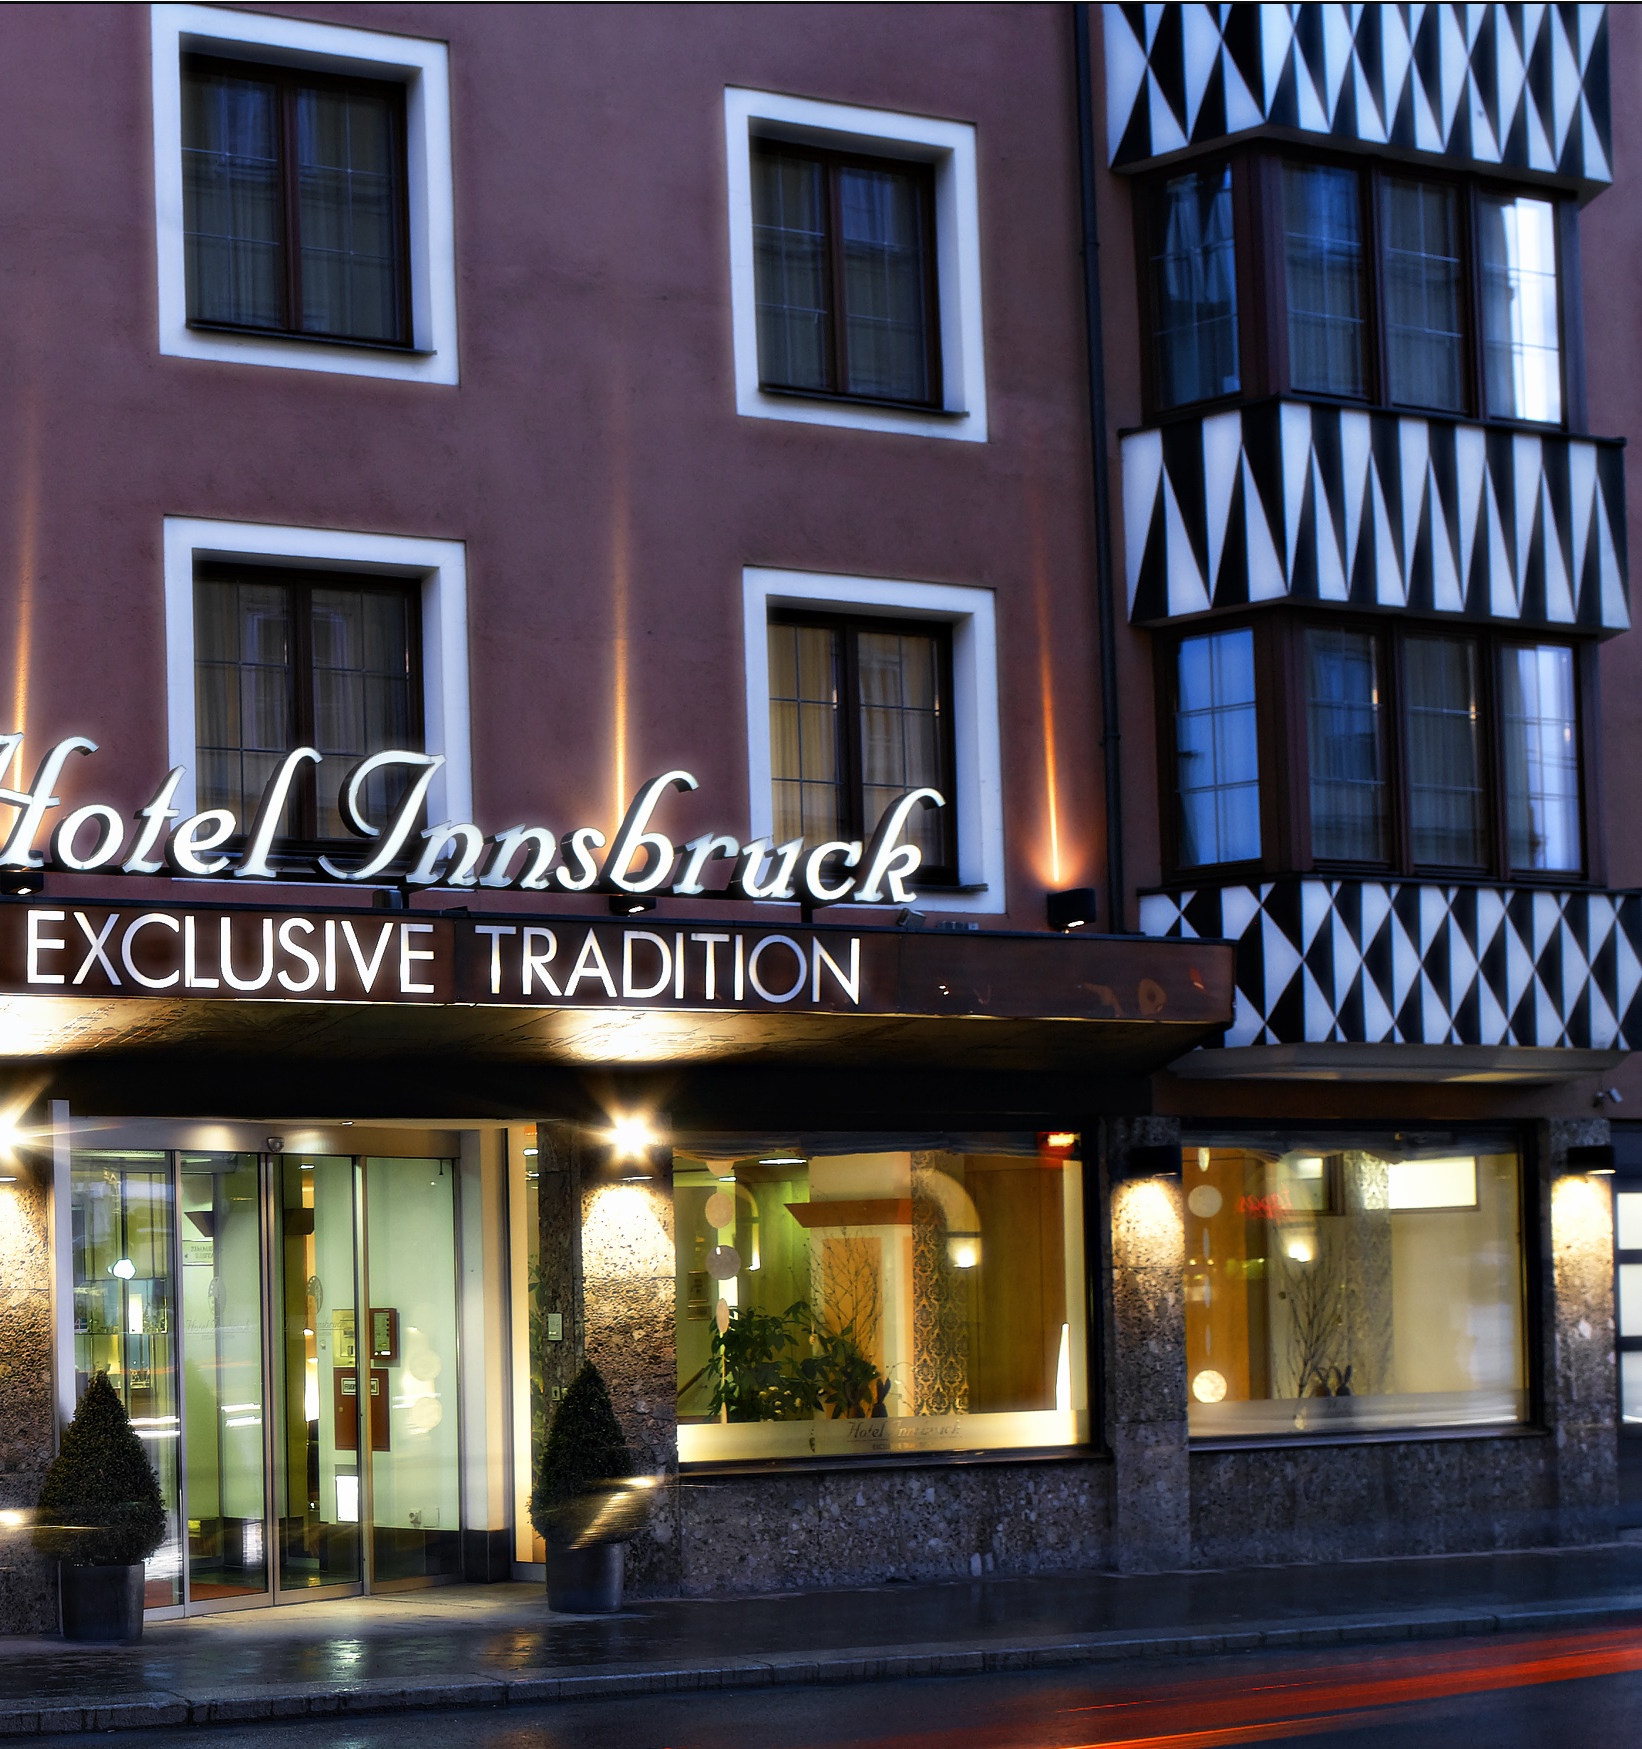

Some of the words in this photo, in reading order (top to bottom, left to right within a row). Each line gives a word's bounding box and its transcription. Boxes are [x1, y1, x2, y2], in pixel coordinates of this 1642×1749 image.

[316, 748, 947, 904] Innsbruck
[25, 908, 436, 994] EXCLUSIVE
[475, 924, 861, 1005] TRADITION
